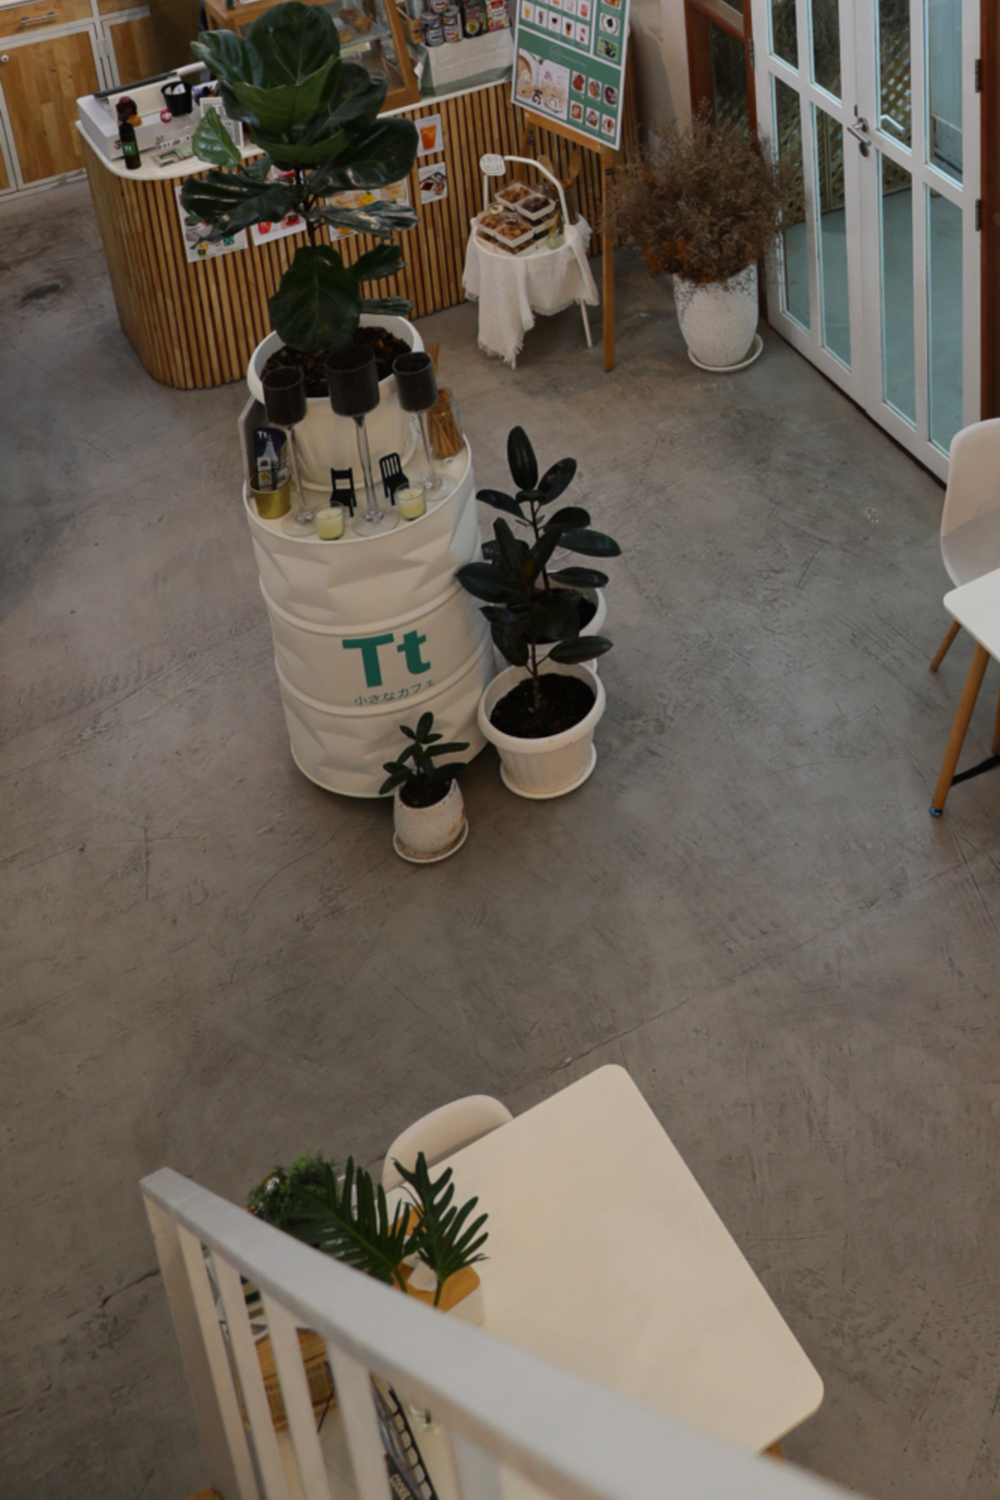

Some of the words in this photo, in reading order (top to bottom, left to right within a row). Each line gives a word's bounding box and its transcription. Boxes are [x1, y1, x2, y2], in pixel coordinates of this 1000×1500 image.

[342, 630, 431, 688] Tt
[354, 679, 434, 705] 小さなカフェ
